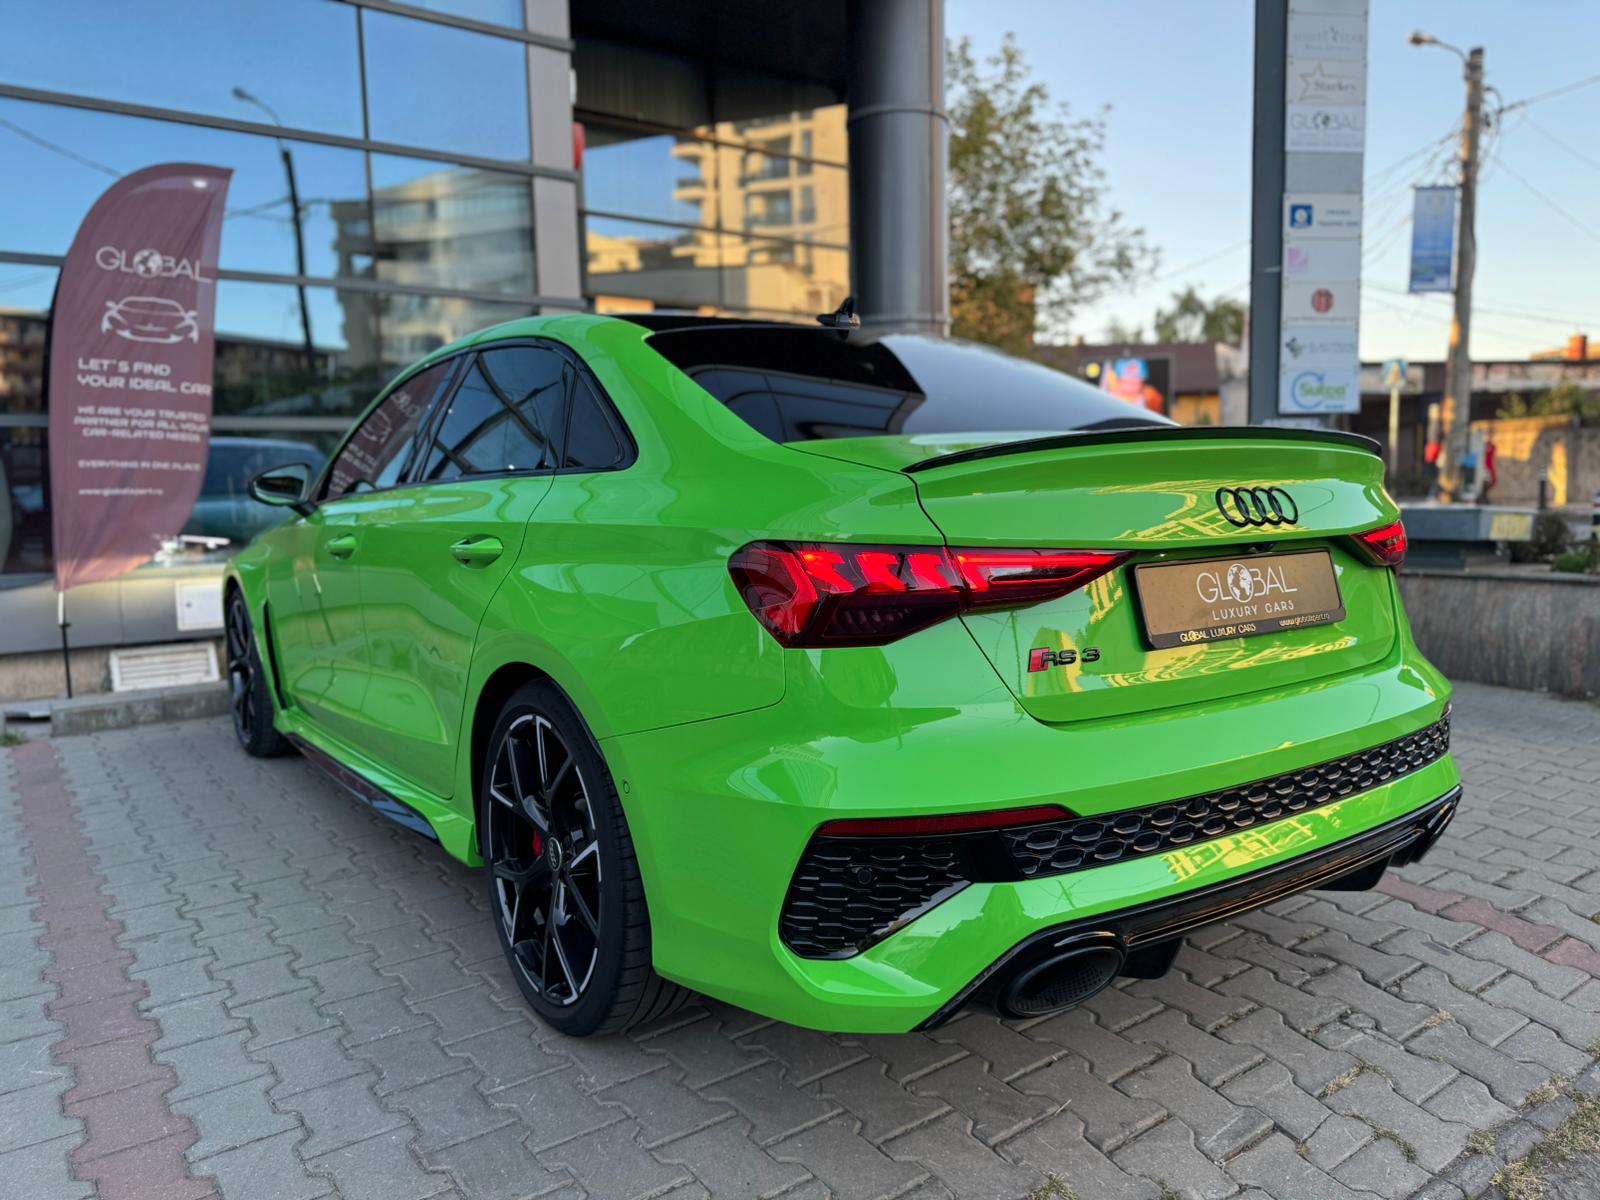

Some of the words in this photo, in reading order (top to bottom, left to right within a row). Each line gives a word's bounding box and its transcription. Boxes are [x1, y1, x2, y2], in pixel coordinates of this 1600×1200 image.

[95, 246, 213, 283] GLOBAL
[78, 358, 130, 373] LET'S
[133, 361, 171, 377] FIND
[77, 374, 125, 389] YOUR
[129, 377, 177, 393] IDEAL
[180, 381, 212, 396] CAR
[78, 405, 96, 416] WE
[97, 406, 121, 417] ARE
[123, 407, 156, 418] YOUR
[158, 409, 207, 422] TRUSTED
[74, 416, 129, 427] PARTNER
[131, 418, 155, 429] FOR
[157, 420, 178, 431] ALL
[180, 421, 209, 433] YOUR
[82, 427, 164, 440] CAR-RELATED
[166, 430, 200, 443] NEEDS
[78, 459, 139, 470] EVERYTHING
[152, 461, 170, 471] ONE
[172, 461, 202, 473] PLACE
[1196, 563, 1298, 603] GLOBAL
[1212, 603, 1259, 621] LUXURY
[1265, 600, 1295, 614] CARS
[1179, 629, 1209, 643] GLOBAL
[1210, 626, 1237, 639] LUXURY
[1237, 623, 1256, 635] CARS
[1036, 649, 1077, 668] RS
[1081, 647, 1101, 664] 3
